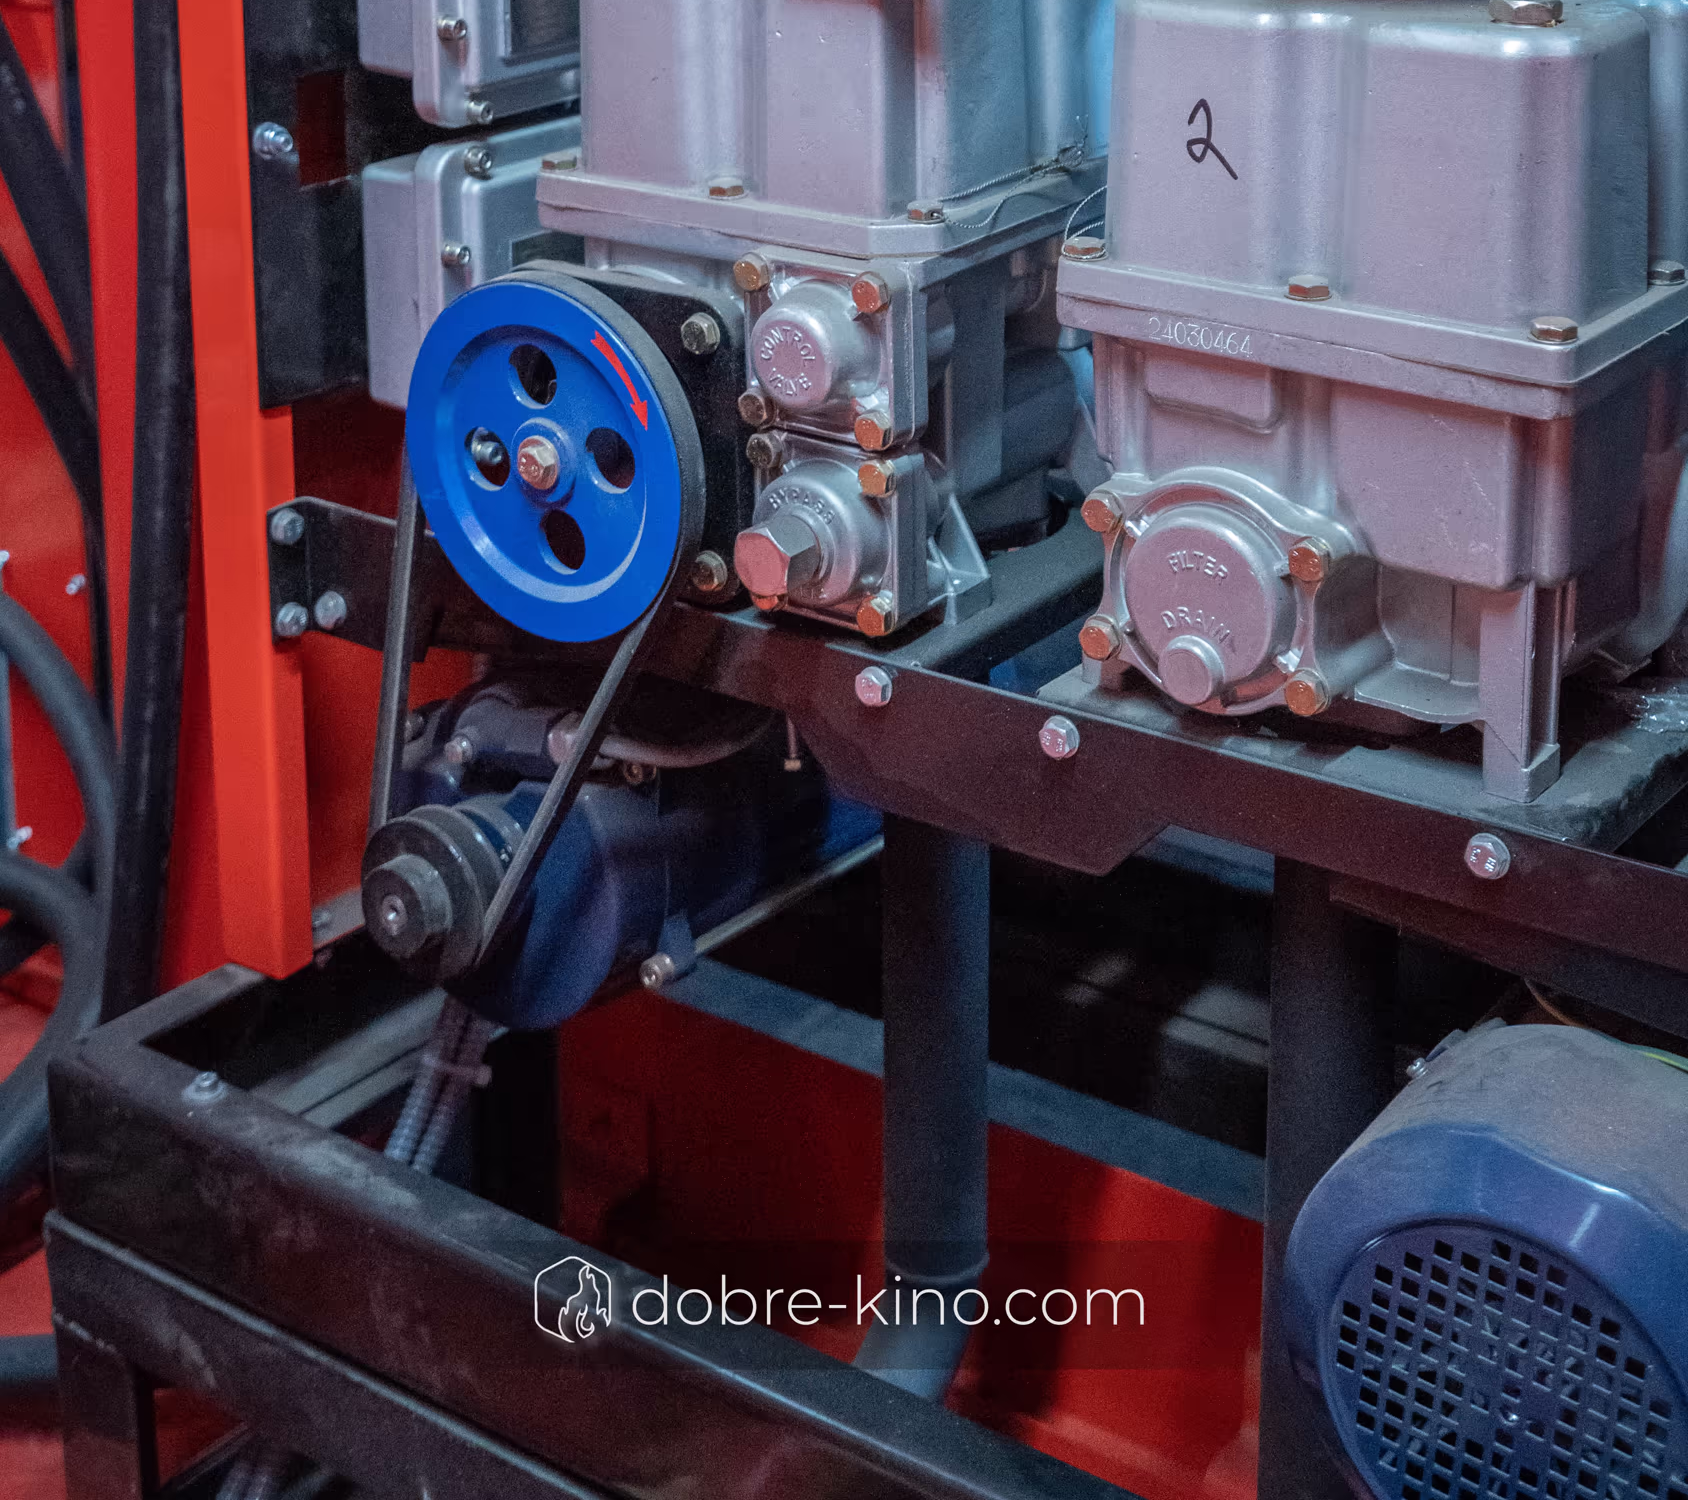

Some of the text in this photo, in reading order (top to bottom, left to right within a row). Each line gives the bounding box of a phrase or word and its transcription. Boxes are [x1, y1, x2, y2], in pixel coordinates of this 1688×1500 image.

[1186, 98, 1239, 180] 2
[760, 326, 816, 368] CONTROL
[1148, 316, 1253, 358] 24030464
[769, 367, 812, 396] VALVE
[769, 486, 835, 525] BYPASS
[1166, 550, 1228, 586] FILTER
[1160, 606, 1231, 644] DRAIN
